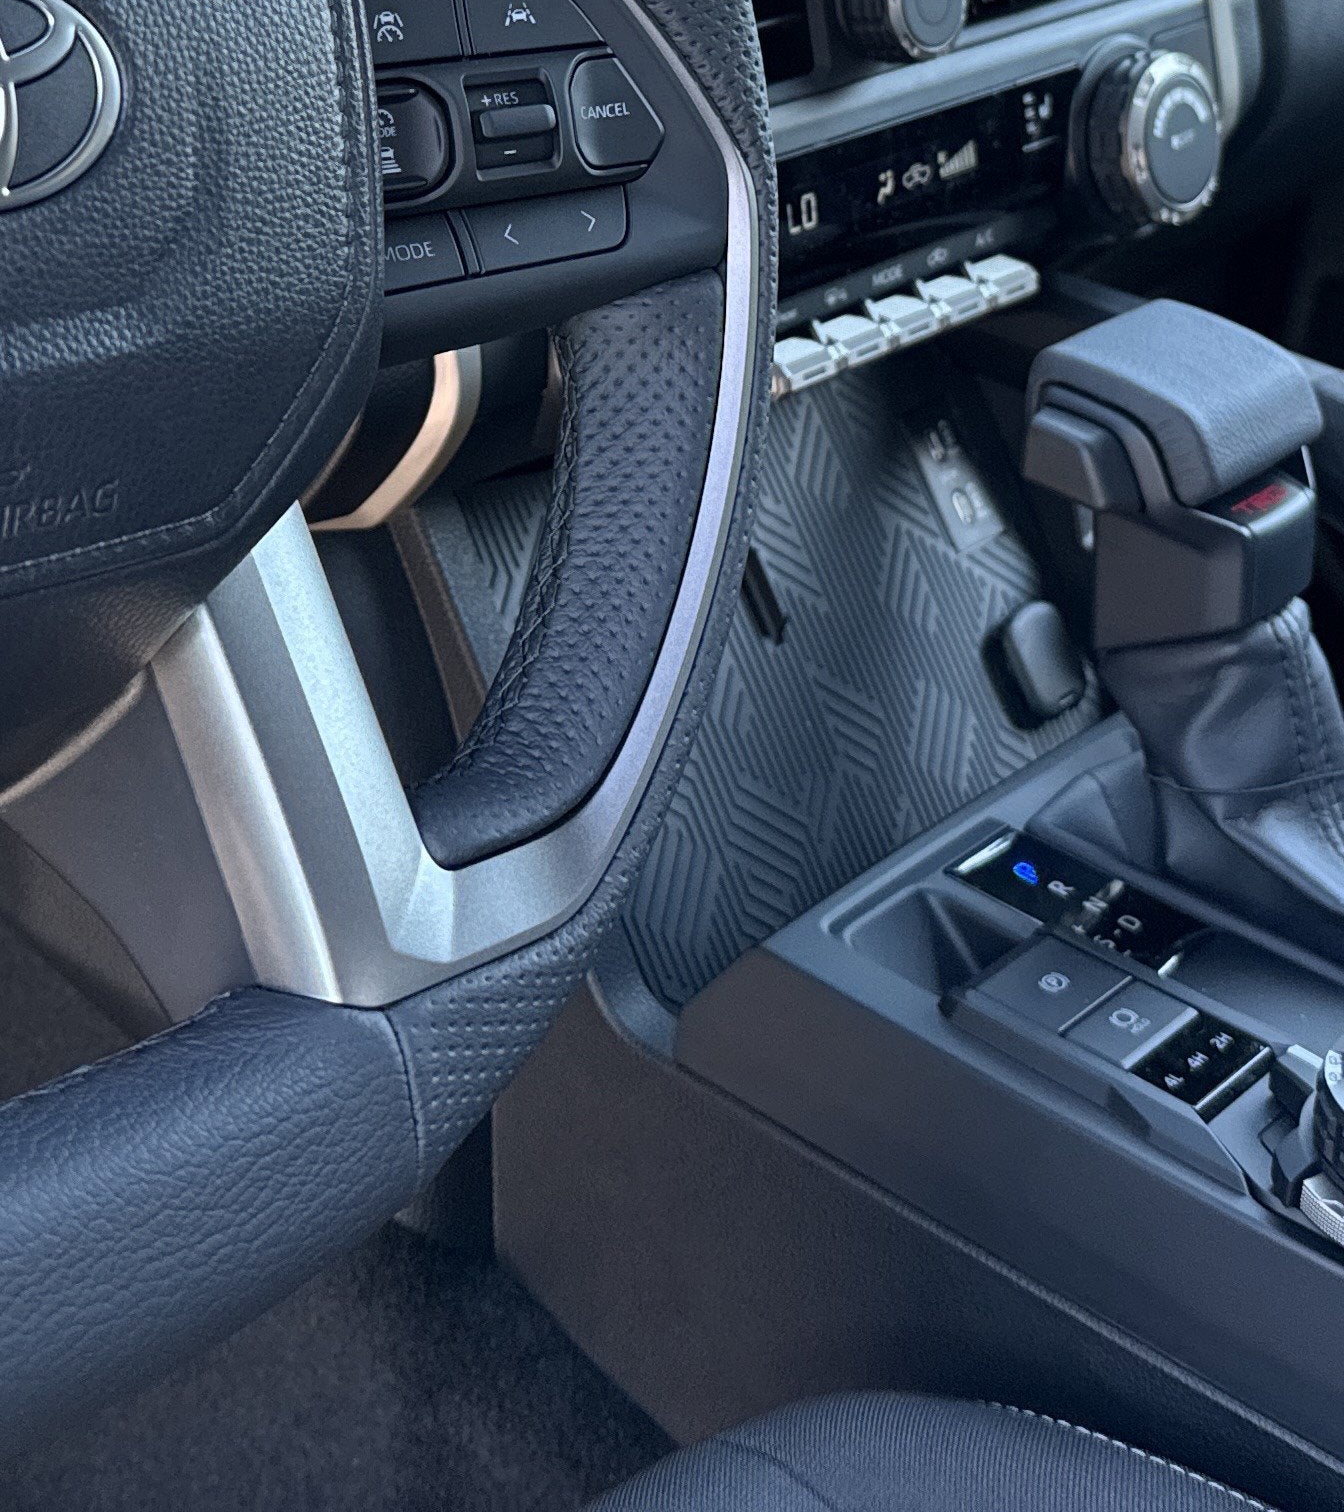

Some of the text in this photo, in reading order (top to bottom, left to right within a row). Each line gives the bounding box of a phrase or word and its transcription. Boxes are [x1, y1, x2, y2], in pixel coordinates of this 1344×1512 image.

[579, 101, 630, 120] CANCEL
[378, 126, 397, 138] ODE
[785, 191, 819, 235] LO
[384, 240, 436, 263] MODE
[1012, 860, 1039, 885] P
[1047, 879, 1074, 899] R
[1082, 895, 1108, 913] N
[1117, 914, 1143, 933] D
[1209, 1030, 1234, 1053] 2H
[1187, 1050, 1209, 1071] 4H
[1164, 1072, 1185, 1089] 4L
